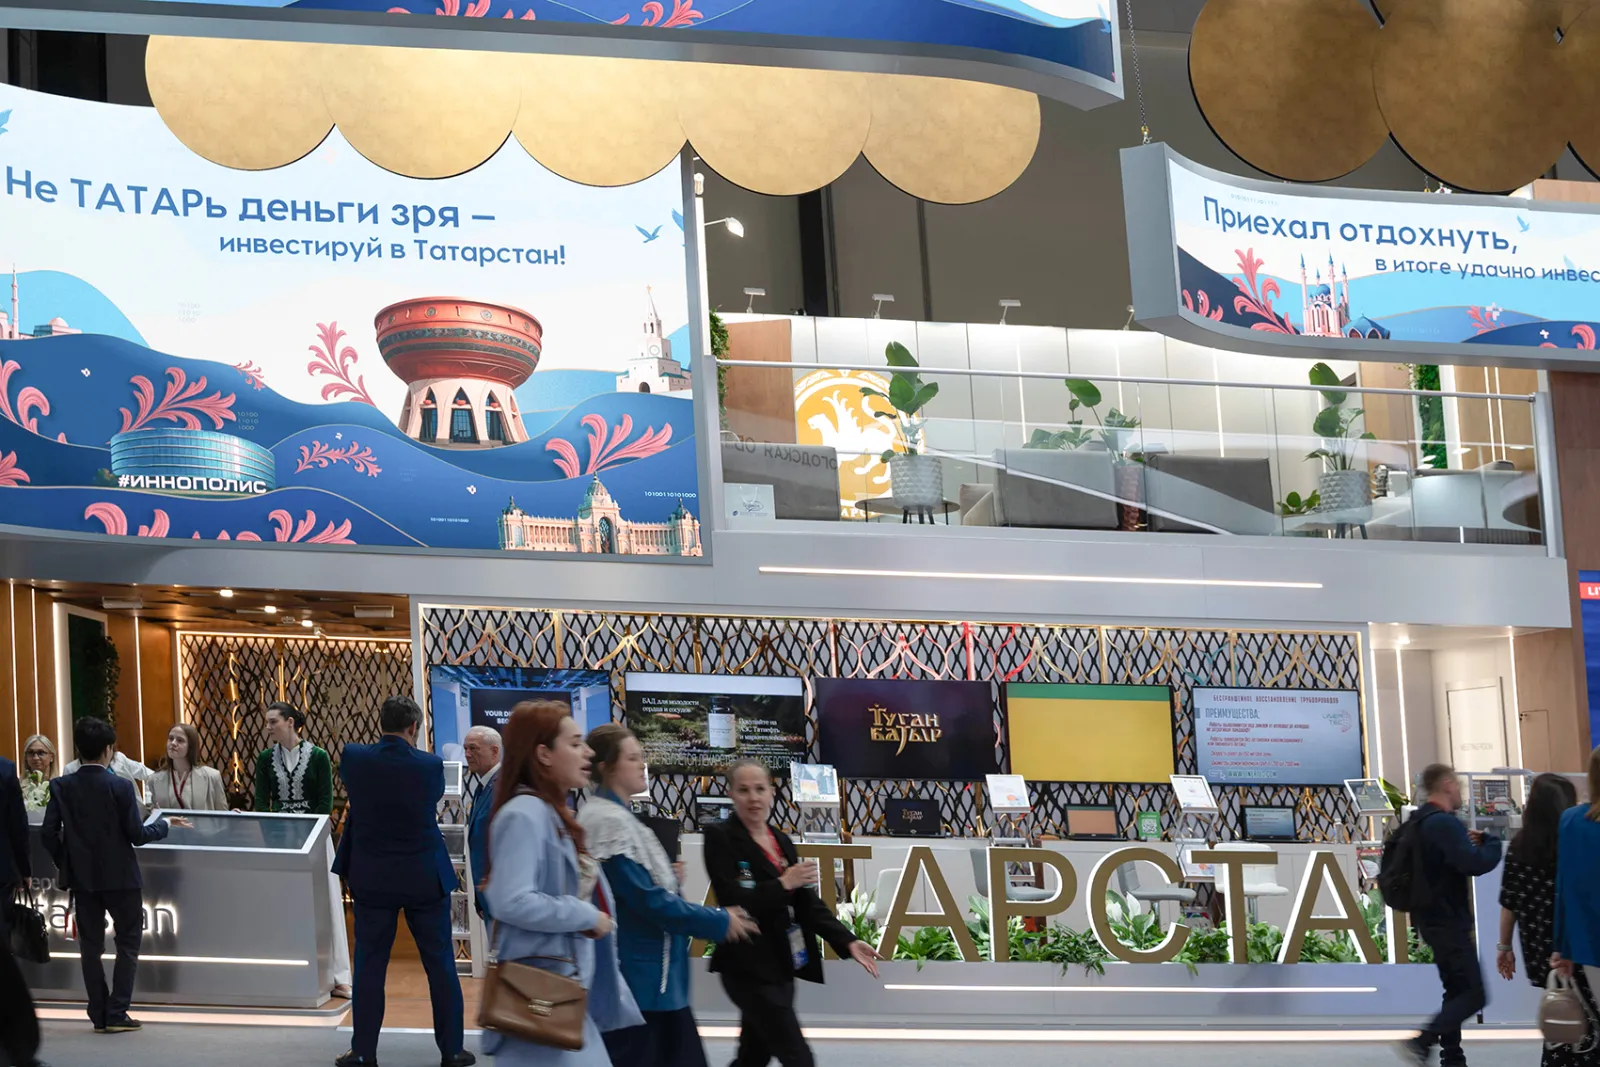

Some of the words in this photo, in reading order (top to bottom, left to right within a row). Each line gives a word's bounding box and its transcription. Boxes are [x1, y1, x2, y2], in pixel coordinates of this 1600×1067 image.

[6, 166, 58, 203] Не
[70, 177, 228, 218] ТАТАРЬ
[239, 198, 379, 225] деньги
[391, 203, 460, 234] зря
[1203, 195, 1331, 241] Приехал
[1339, 221, 1518, 255] отдохнуть,
[219, 236, 383, 263] инвестируй
[390, 243, 406, 259] в
[413, 239, 566, 267] Татарстан!
[1375, 258, 1388, 271] в
[1393, 259, 1451, 275] итоге
[1457, 262, 1536, 280] удачно
[118, 474, 267, 494] #ИННОПОЛИС
[641, 697, 656, 705] БАД
